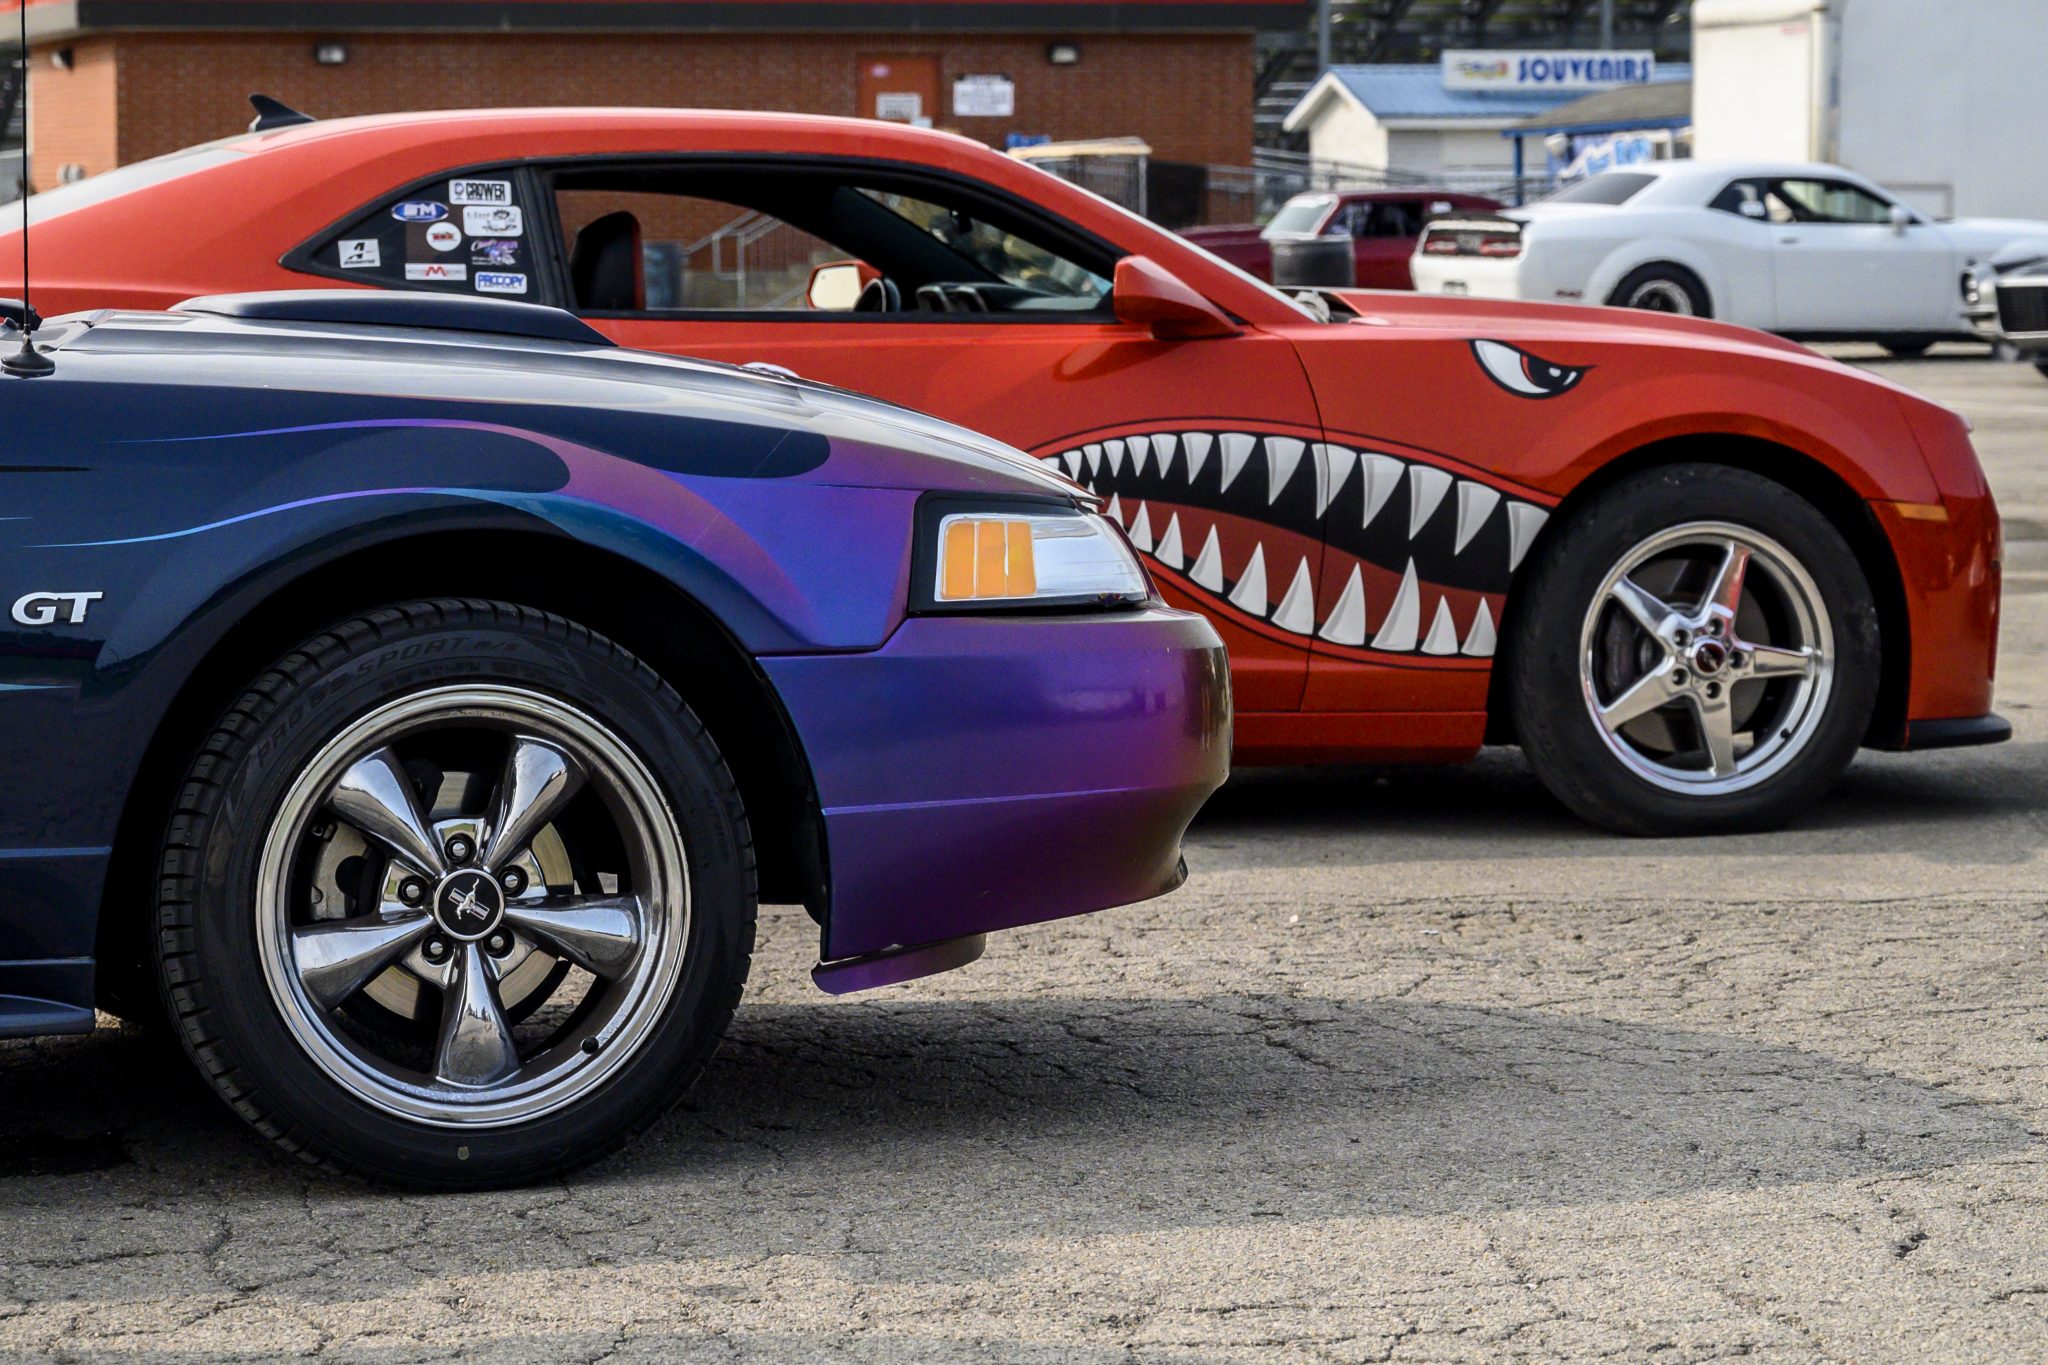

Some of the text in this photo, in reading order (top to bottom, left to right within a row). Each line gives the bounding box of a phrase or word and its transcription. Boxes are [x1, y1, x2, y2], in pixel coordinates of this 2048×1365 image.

[1518, 58, 1649, 82] SOUVENIRS
[466, 183, 505, 200] CROWER
[11, 592, 103, 625] GT
[355, 637, 470, 677] SPORT
